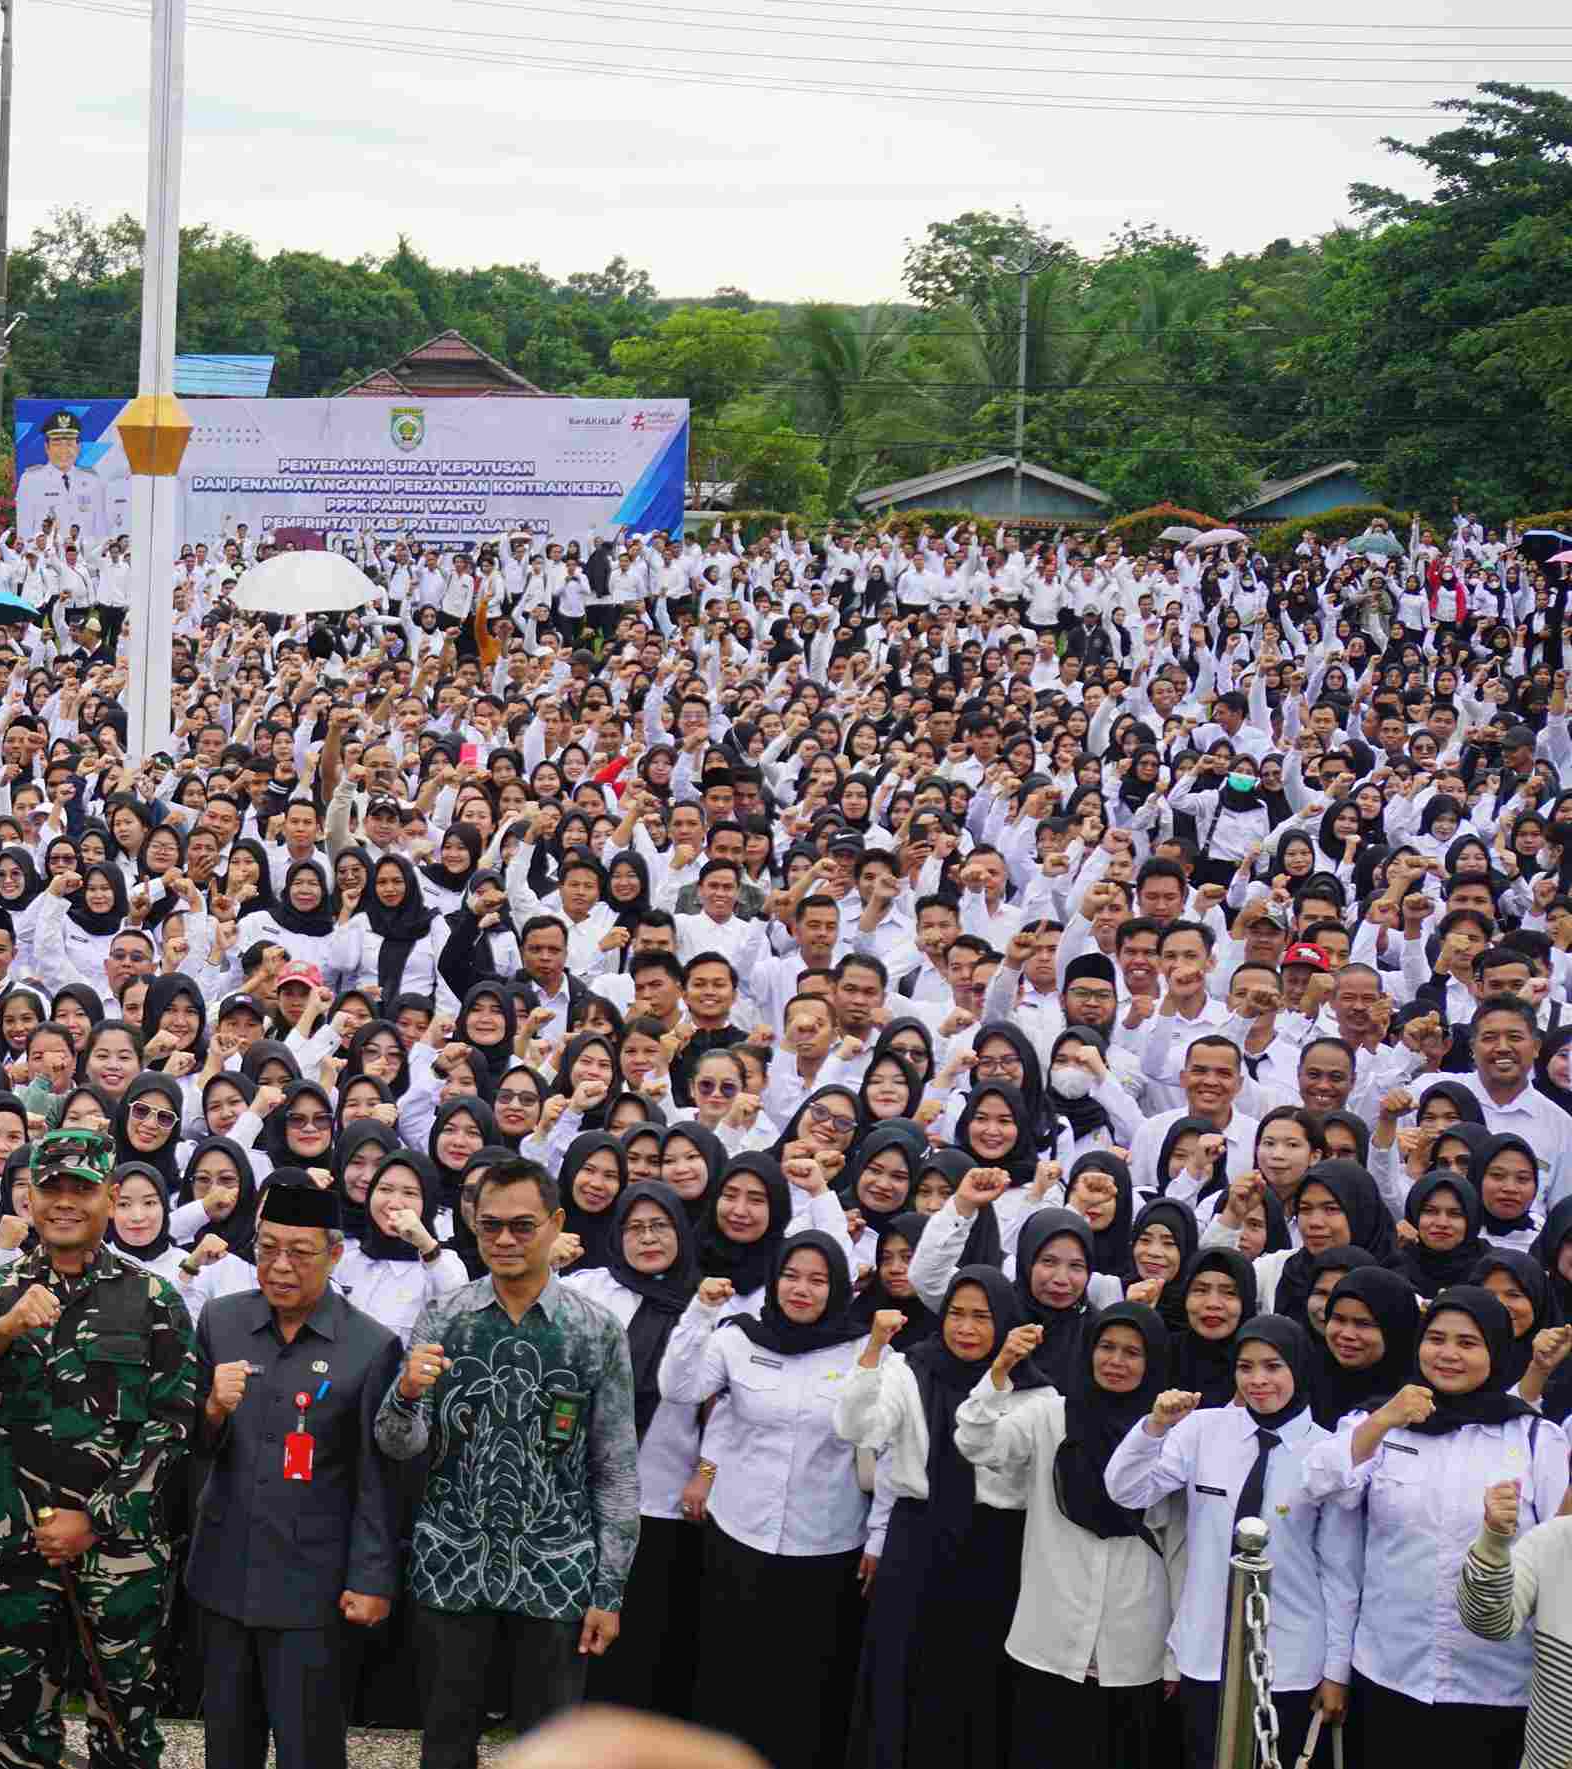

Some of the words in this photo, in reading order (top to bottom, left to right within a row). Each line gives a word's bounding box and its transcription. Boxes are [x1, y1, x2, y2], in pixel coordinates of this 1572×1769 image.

[278, 458, 384, 474] PENYERAHAN
[387, 459, 439, 475] SURAT
[441, 460, 535, 476] KEPUTUSAN
[192, 476, 227, 492] DAN
[229, 477, 391, 495] PENANDATANGANAN
[394, 479, 490, 496] PERJANJIAN
[492, 480, 569, 497] KONTRAK
[570, 481, 624, 497] KERJA
[325, 497, 369, 513] PPPK
[371, 498, 426, 514] PARUH
[428, 499, 486, 514] WAKTU
